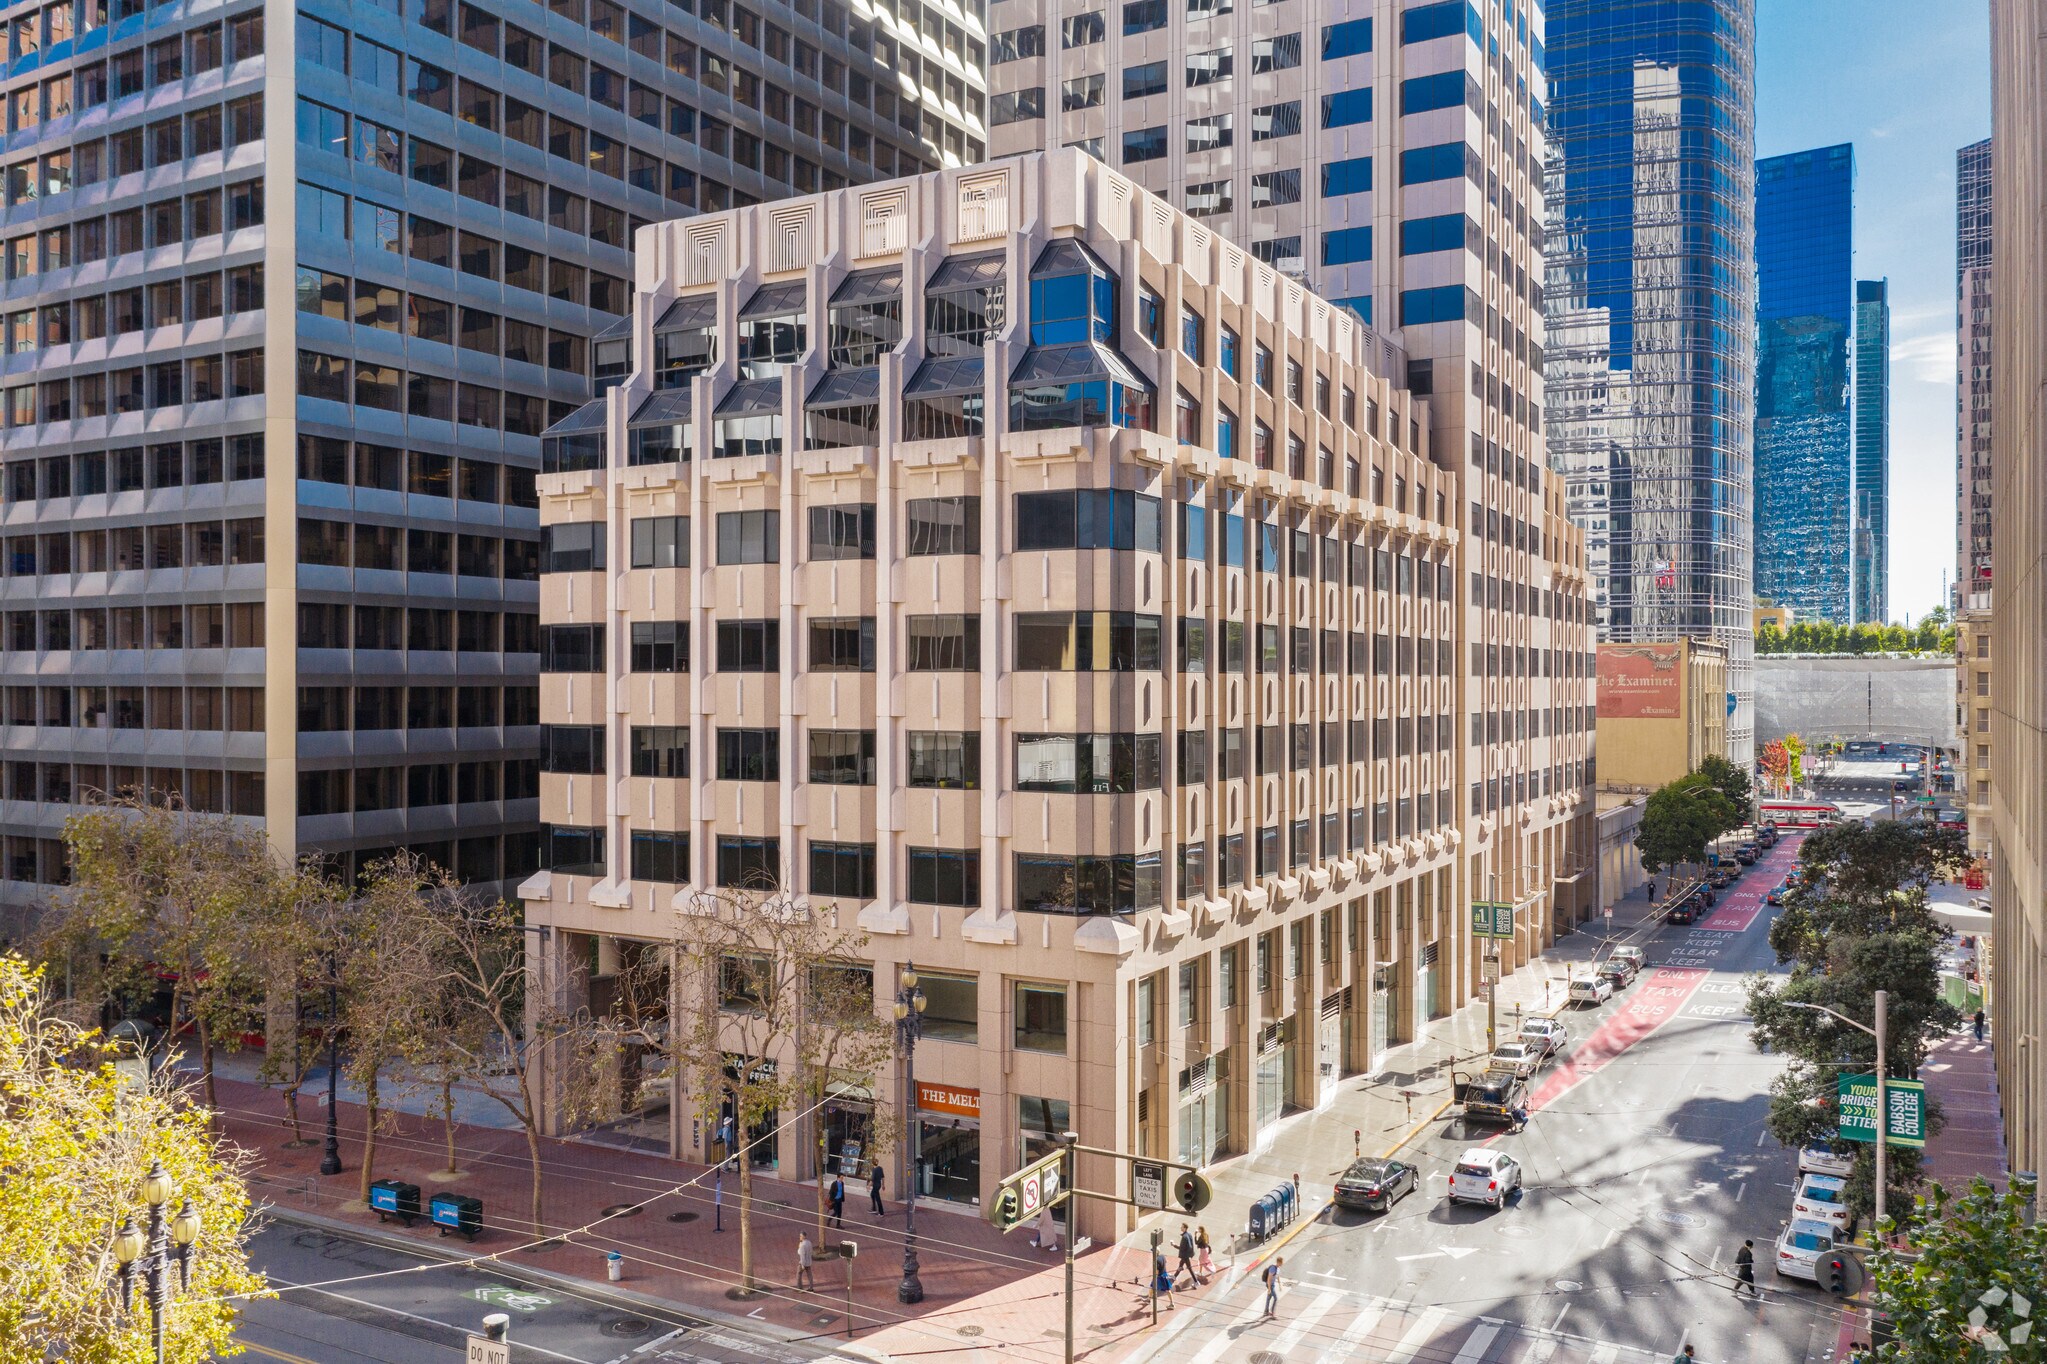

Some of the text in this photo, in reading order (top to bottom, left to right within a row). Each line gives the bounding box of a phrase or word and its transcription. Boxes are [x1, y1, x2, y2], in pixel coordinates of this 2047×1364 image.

[1617, 674, 1677, 687] Examiner.
[1496, 909, 1504, 933] BABSON
[1503, 909, 1511, 933] COLLEGE
[1688, 931, 1734, 939] CLEAR
[1685, 939, 1723, 947] KEEP
[1671, 948, 1719, 957] CLEAR
[1665, 957, 1706, 966] KEEP
[1657, 970, 1702, 980] ONLY
[1644, 987, 1686, 997] TAXI
[1701, 984, 1746, 994] CLEA
[1628, 1005, 1667, 1015] BUS
[1688, 1005, 1737, 1016] KEEP
[1850, 1085, 1877, 1097] YOUR
[922, 1089, 980, 1108] THE MELT
[1840, 1094, 1878, 1108] BRIDGE
[1865, 1107, 1877, 1118] TO
[1890, 1090, 1905, 1134] BABSON
[1905, 1092, 1919, 1136] COLLEGE
[1840, 1115, 1877, 1129] BETTER
[1138, 1178, 1158, 1186] BUSES
[471, 1346, 505, 1364] DO NOT
